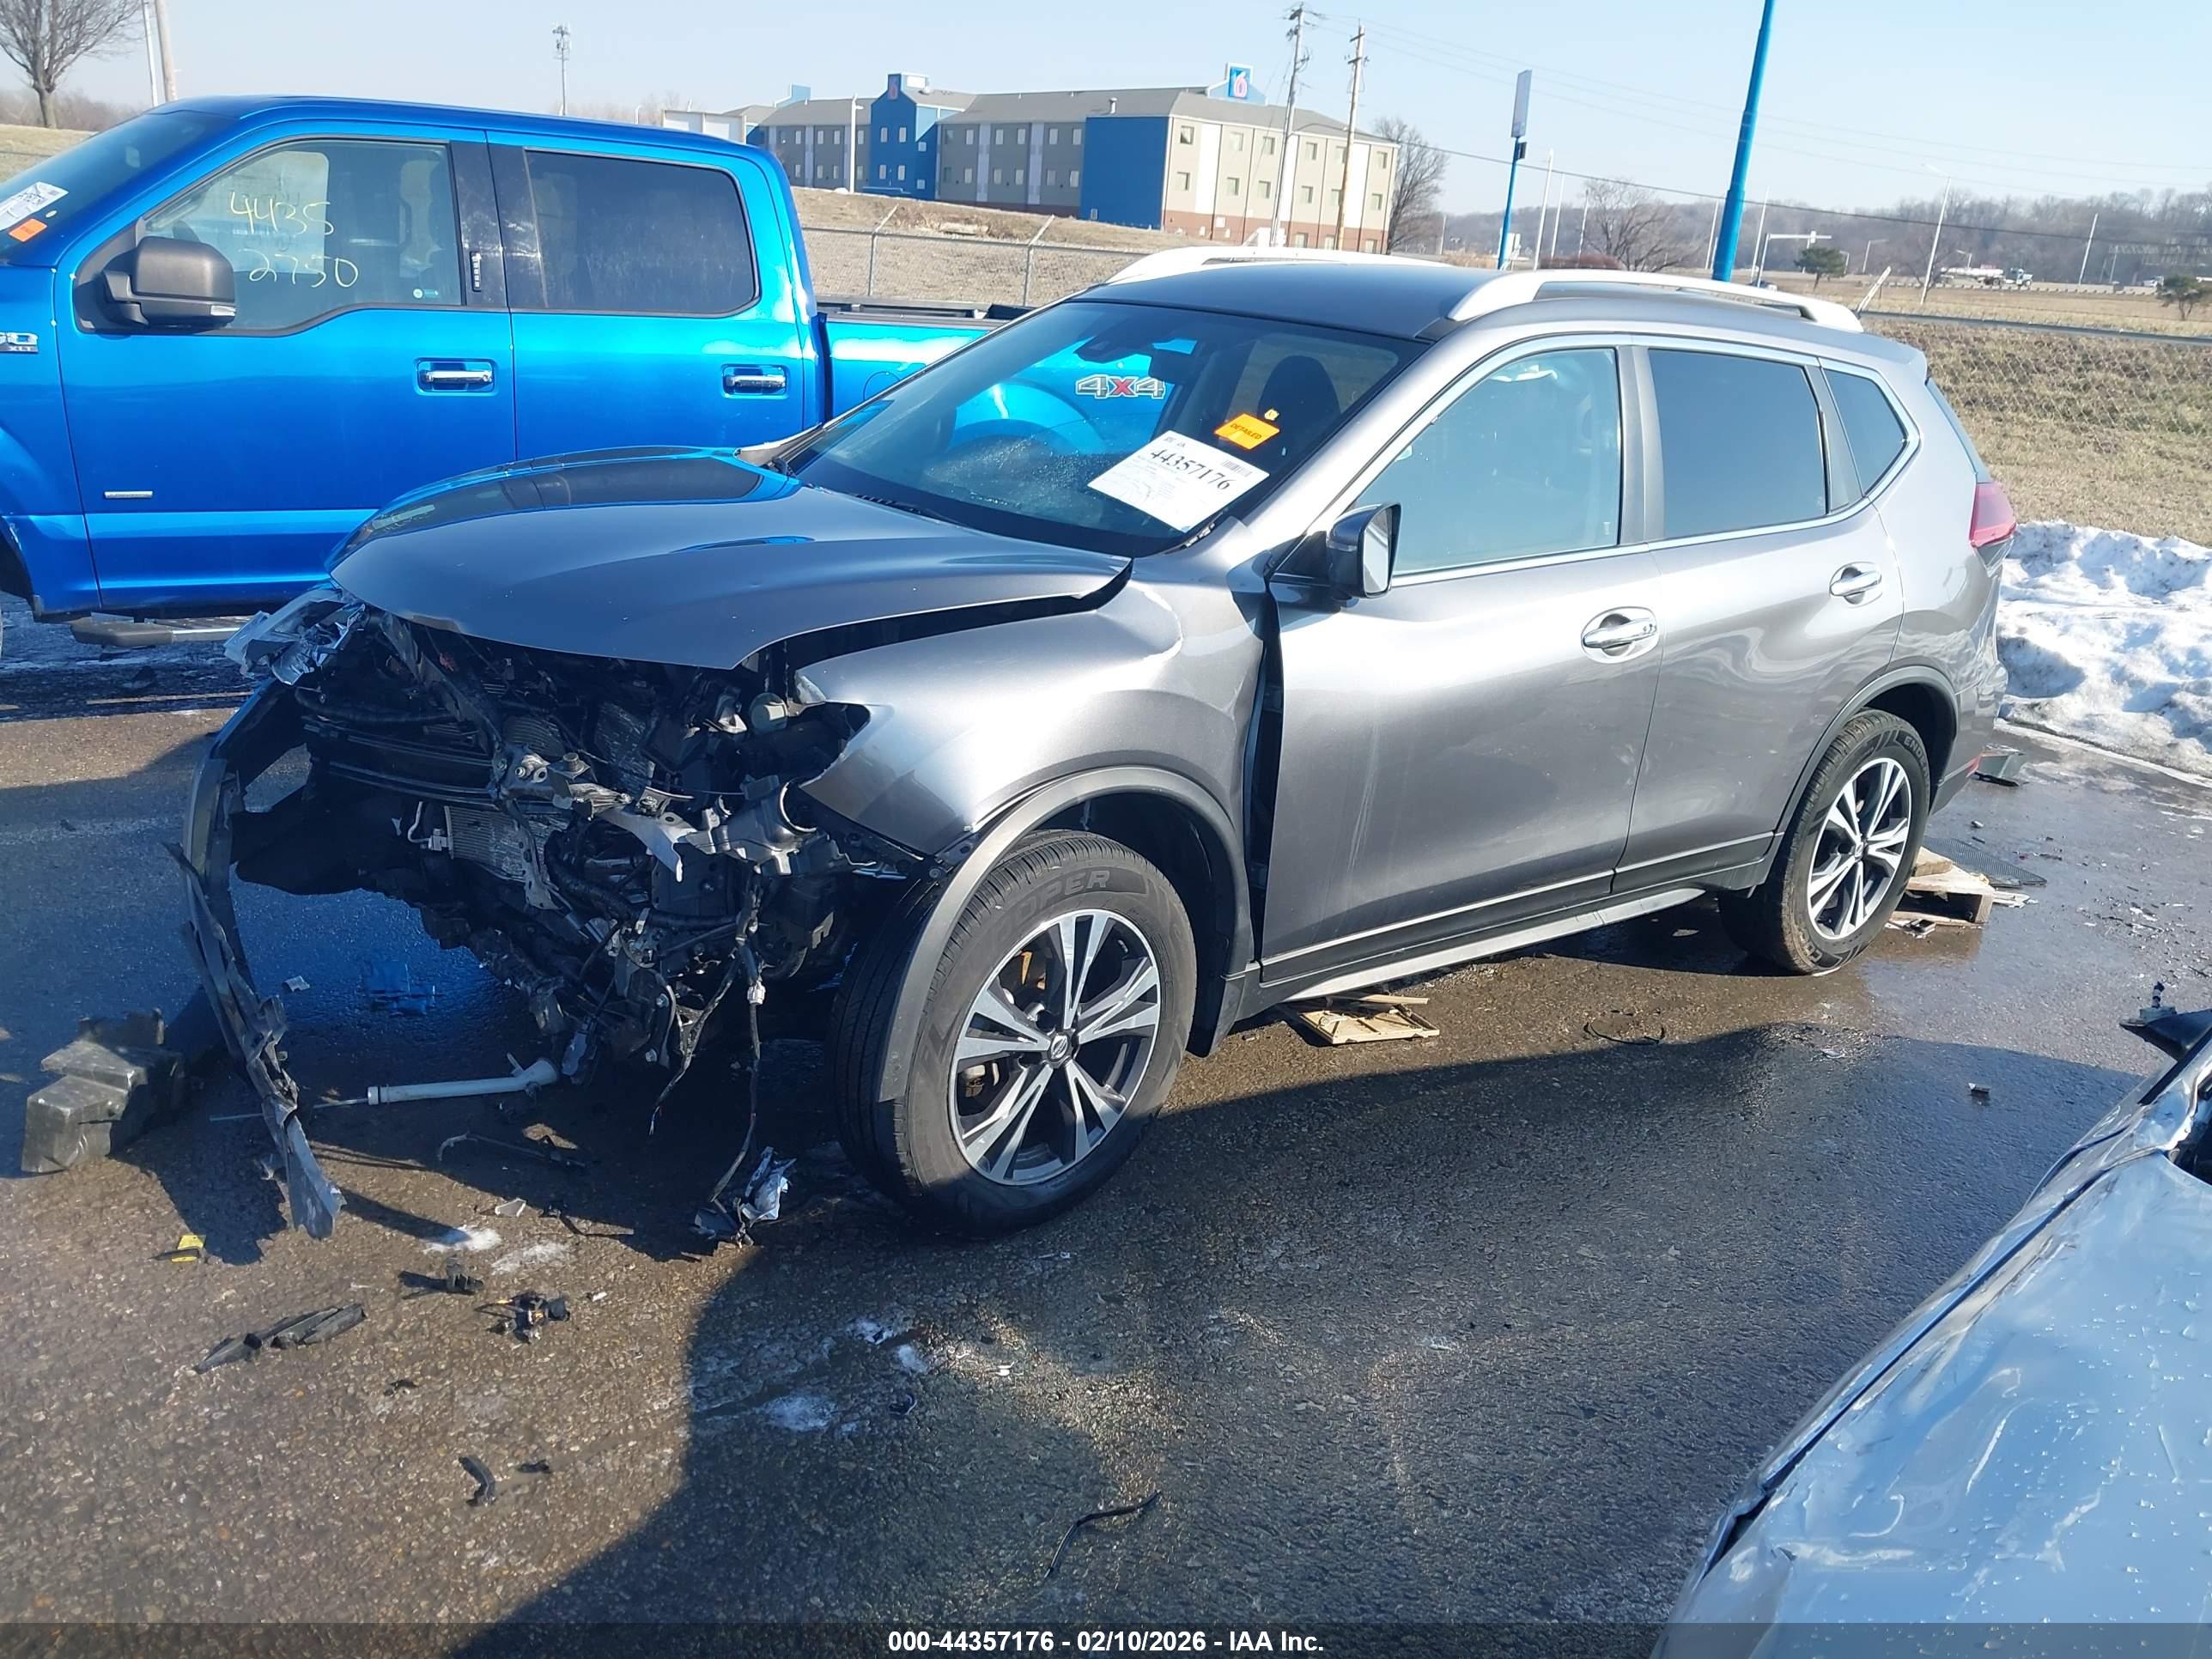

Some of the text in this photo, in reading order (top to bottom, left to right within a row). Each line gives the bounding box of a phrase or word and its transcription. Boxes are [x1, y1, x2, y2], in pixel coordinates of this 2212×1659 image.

[230, 191, 335, 236] 4435
[238, 248, 359, 288] 2750
[1230, 423, 1262, 440] DETAILED
[1150, 448, 1238, 491] 44357176
